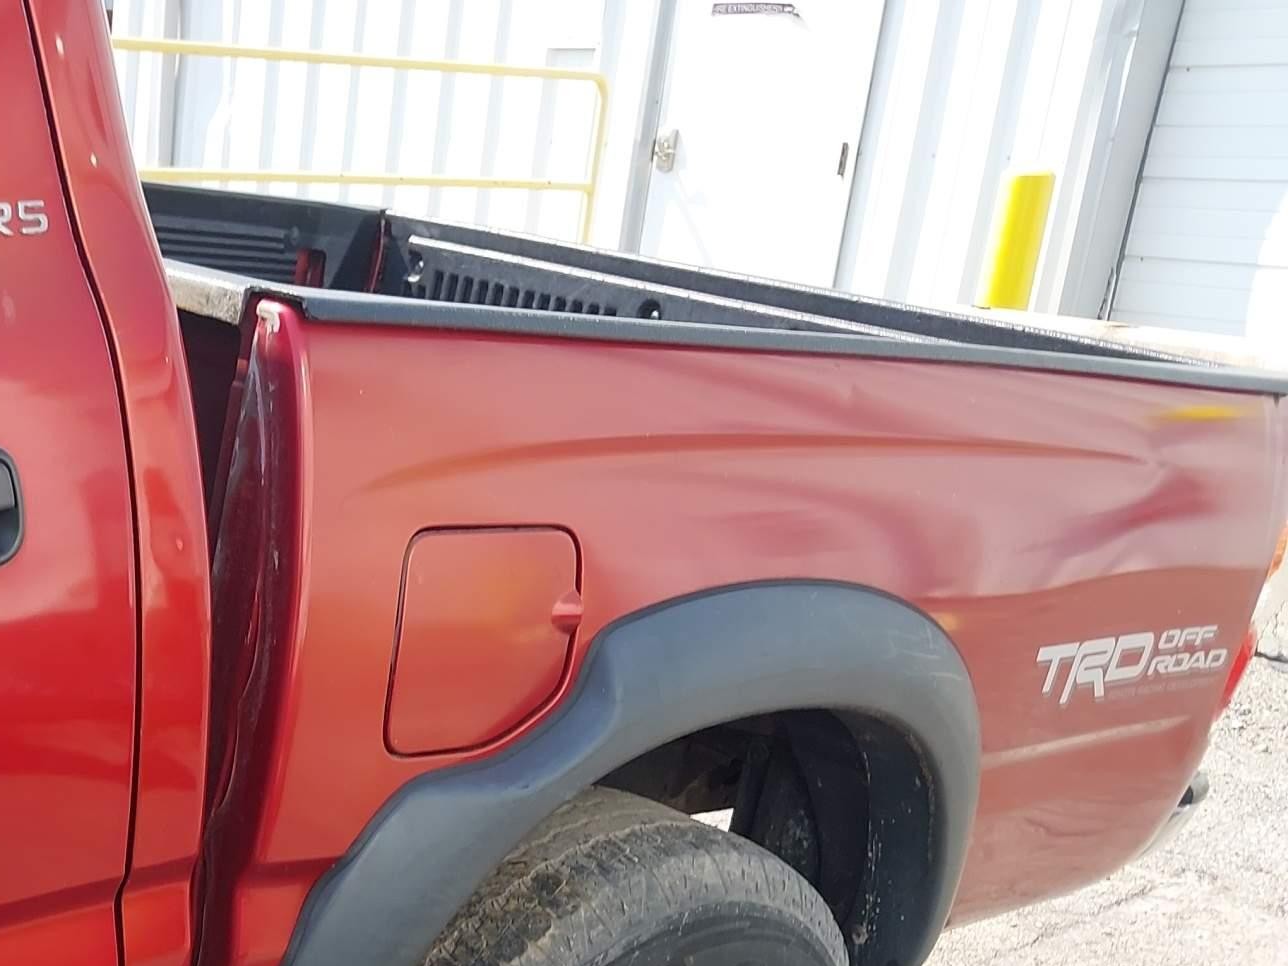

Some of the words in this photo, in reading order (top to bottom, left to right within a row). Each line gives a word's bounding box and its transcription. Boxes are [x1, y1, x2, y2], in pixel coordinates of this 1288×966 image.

[1158, 625, 1218, 650] OFF
[1036, 632, 1154, 705] TRD
[1147, 649, 1228, 676] ROAD
